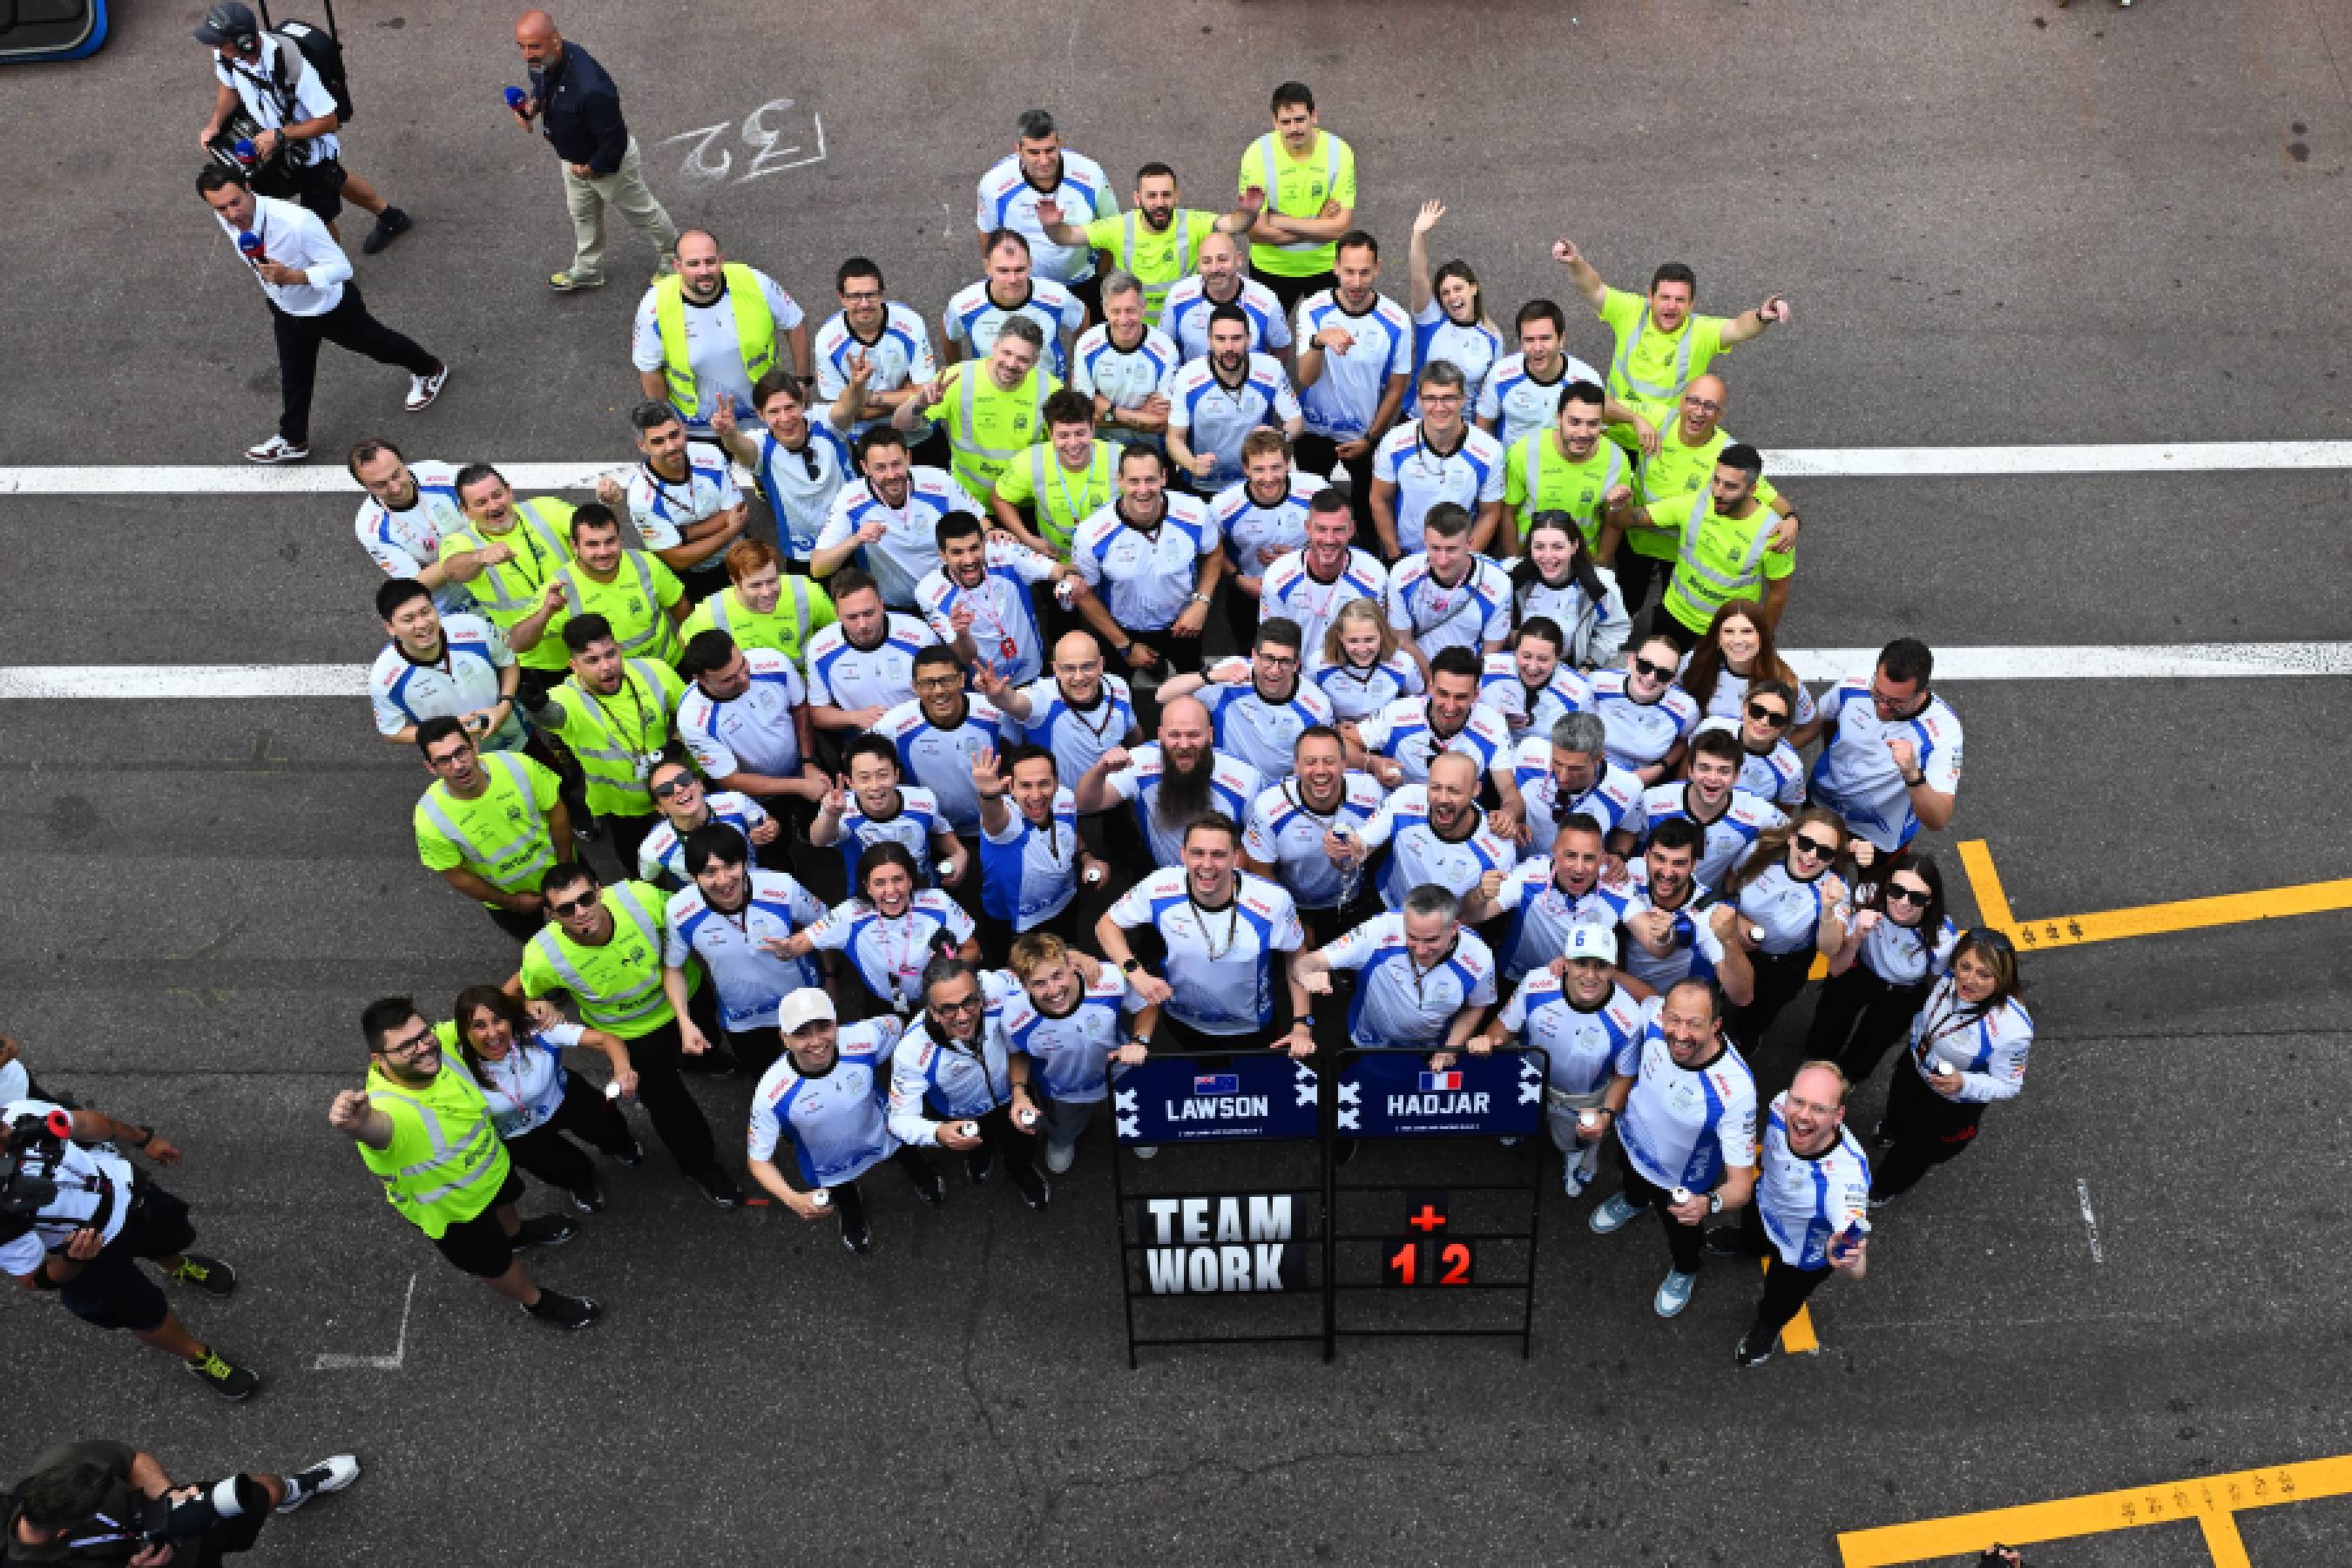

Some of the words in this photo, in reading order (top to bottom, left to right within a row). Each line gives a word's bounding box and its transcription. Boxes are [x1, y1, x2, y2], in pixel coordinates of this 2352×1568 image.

[1166, 1095, 1267, 1121] LAWSON
[1388, 1092, 1490, 1116] HADJAR
[1147, 1194, 1292, 1245] TEAM
[1146, 1243, 1285, 1294] WORK
[1390, 1243, 1470, 1285] 12
